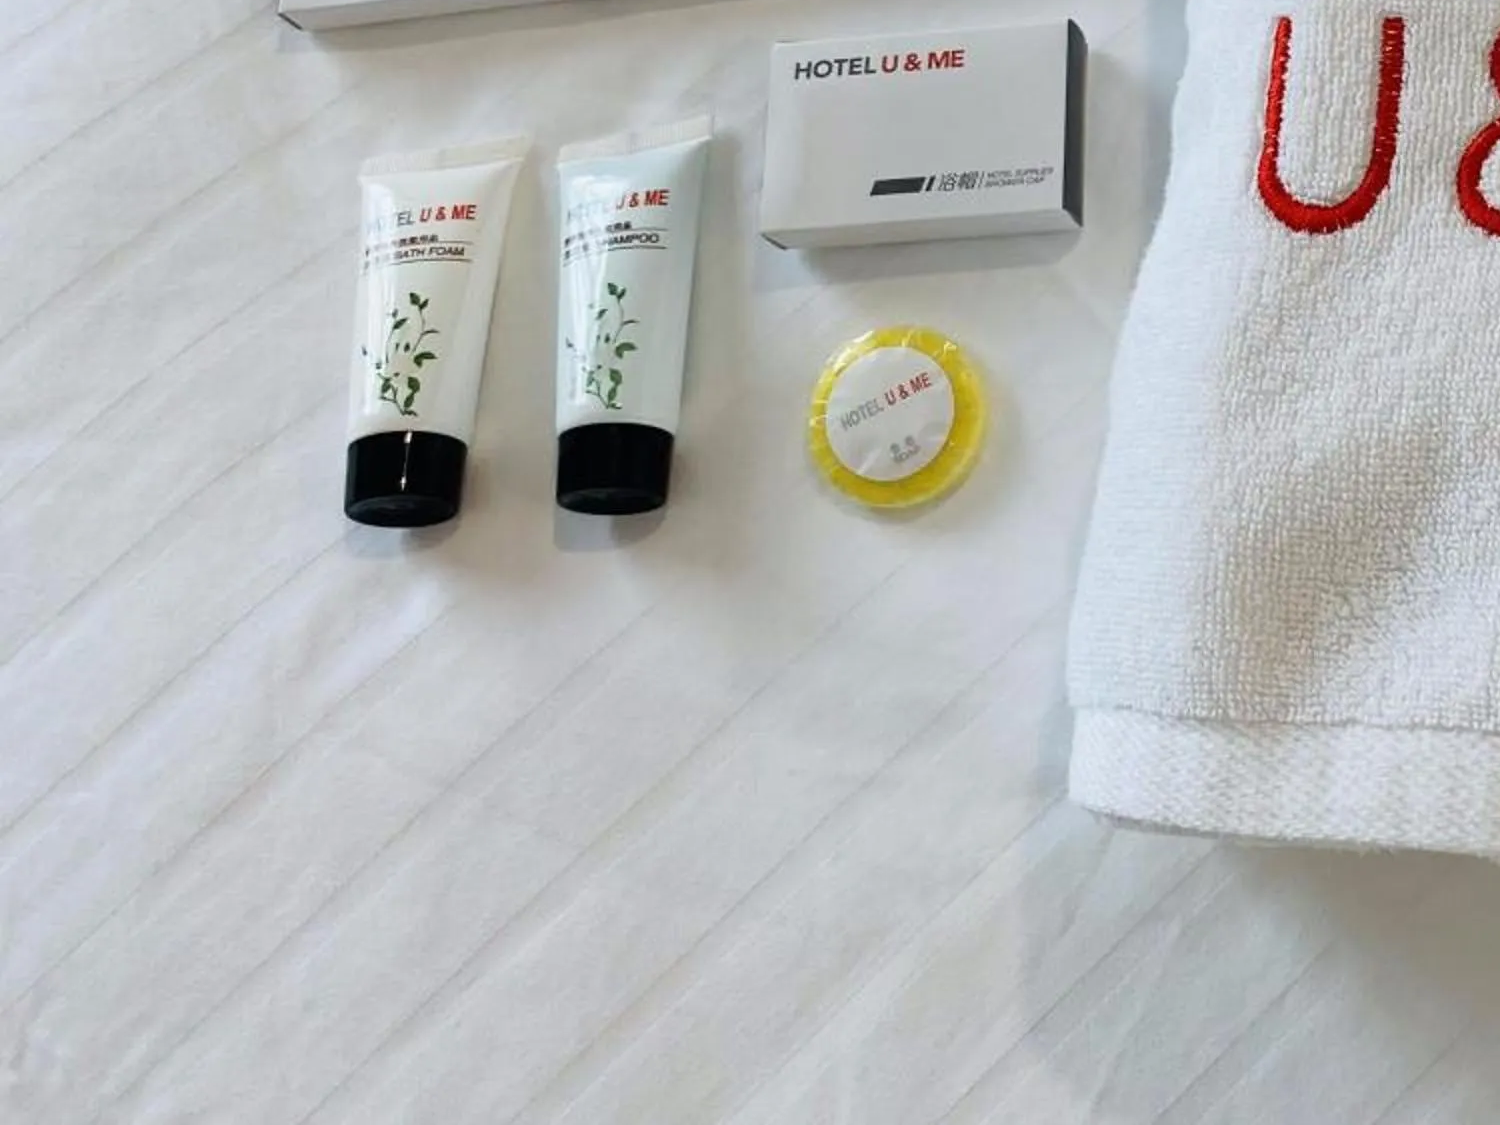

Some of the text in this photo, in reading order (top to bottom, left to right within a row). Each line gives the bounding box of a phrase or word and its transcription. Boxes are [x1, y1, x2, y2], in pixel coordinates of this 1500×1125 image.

[793, 49, 966, 80] HOTEL U & ME
[1258, 16, 1405, 234] U
[419, 206, 433, 223] U
[435, 205, 447, 222] &
[451, 203, 478, 221] ME
[628, 191, 641, 209] &
[643, 188, 671, 207] ME
[839, 398, 885, 432] HOTEL
[884, 389, 897, 407] U
[908, 371, 934, 395] ME
